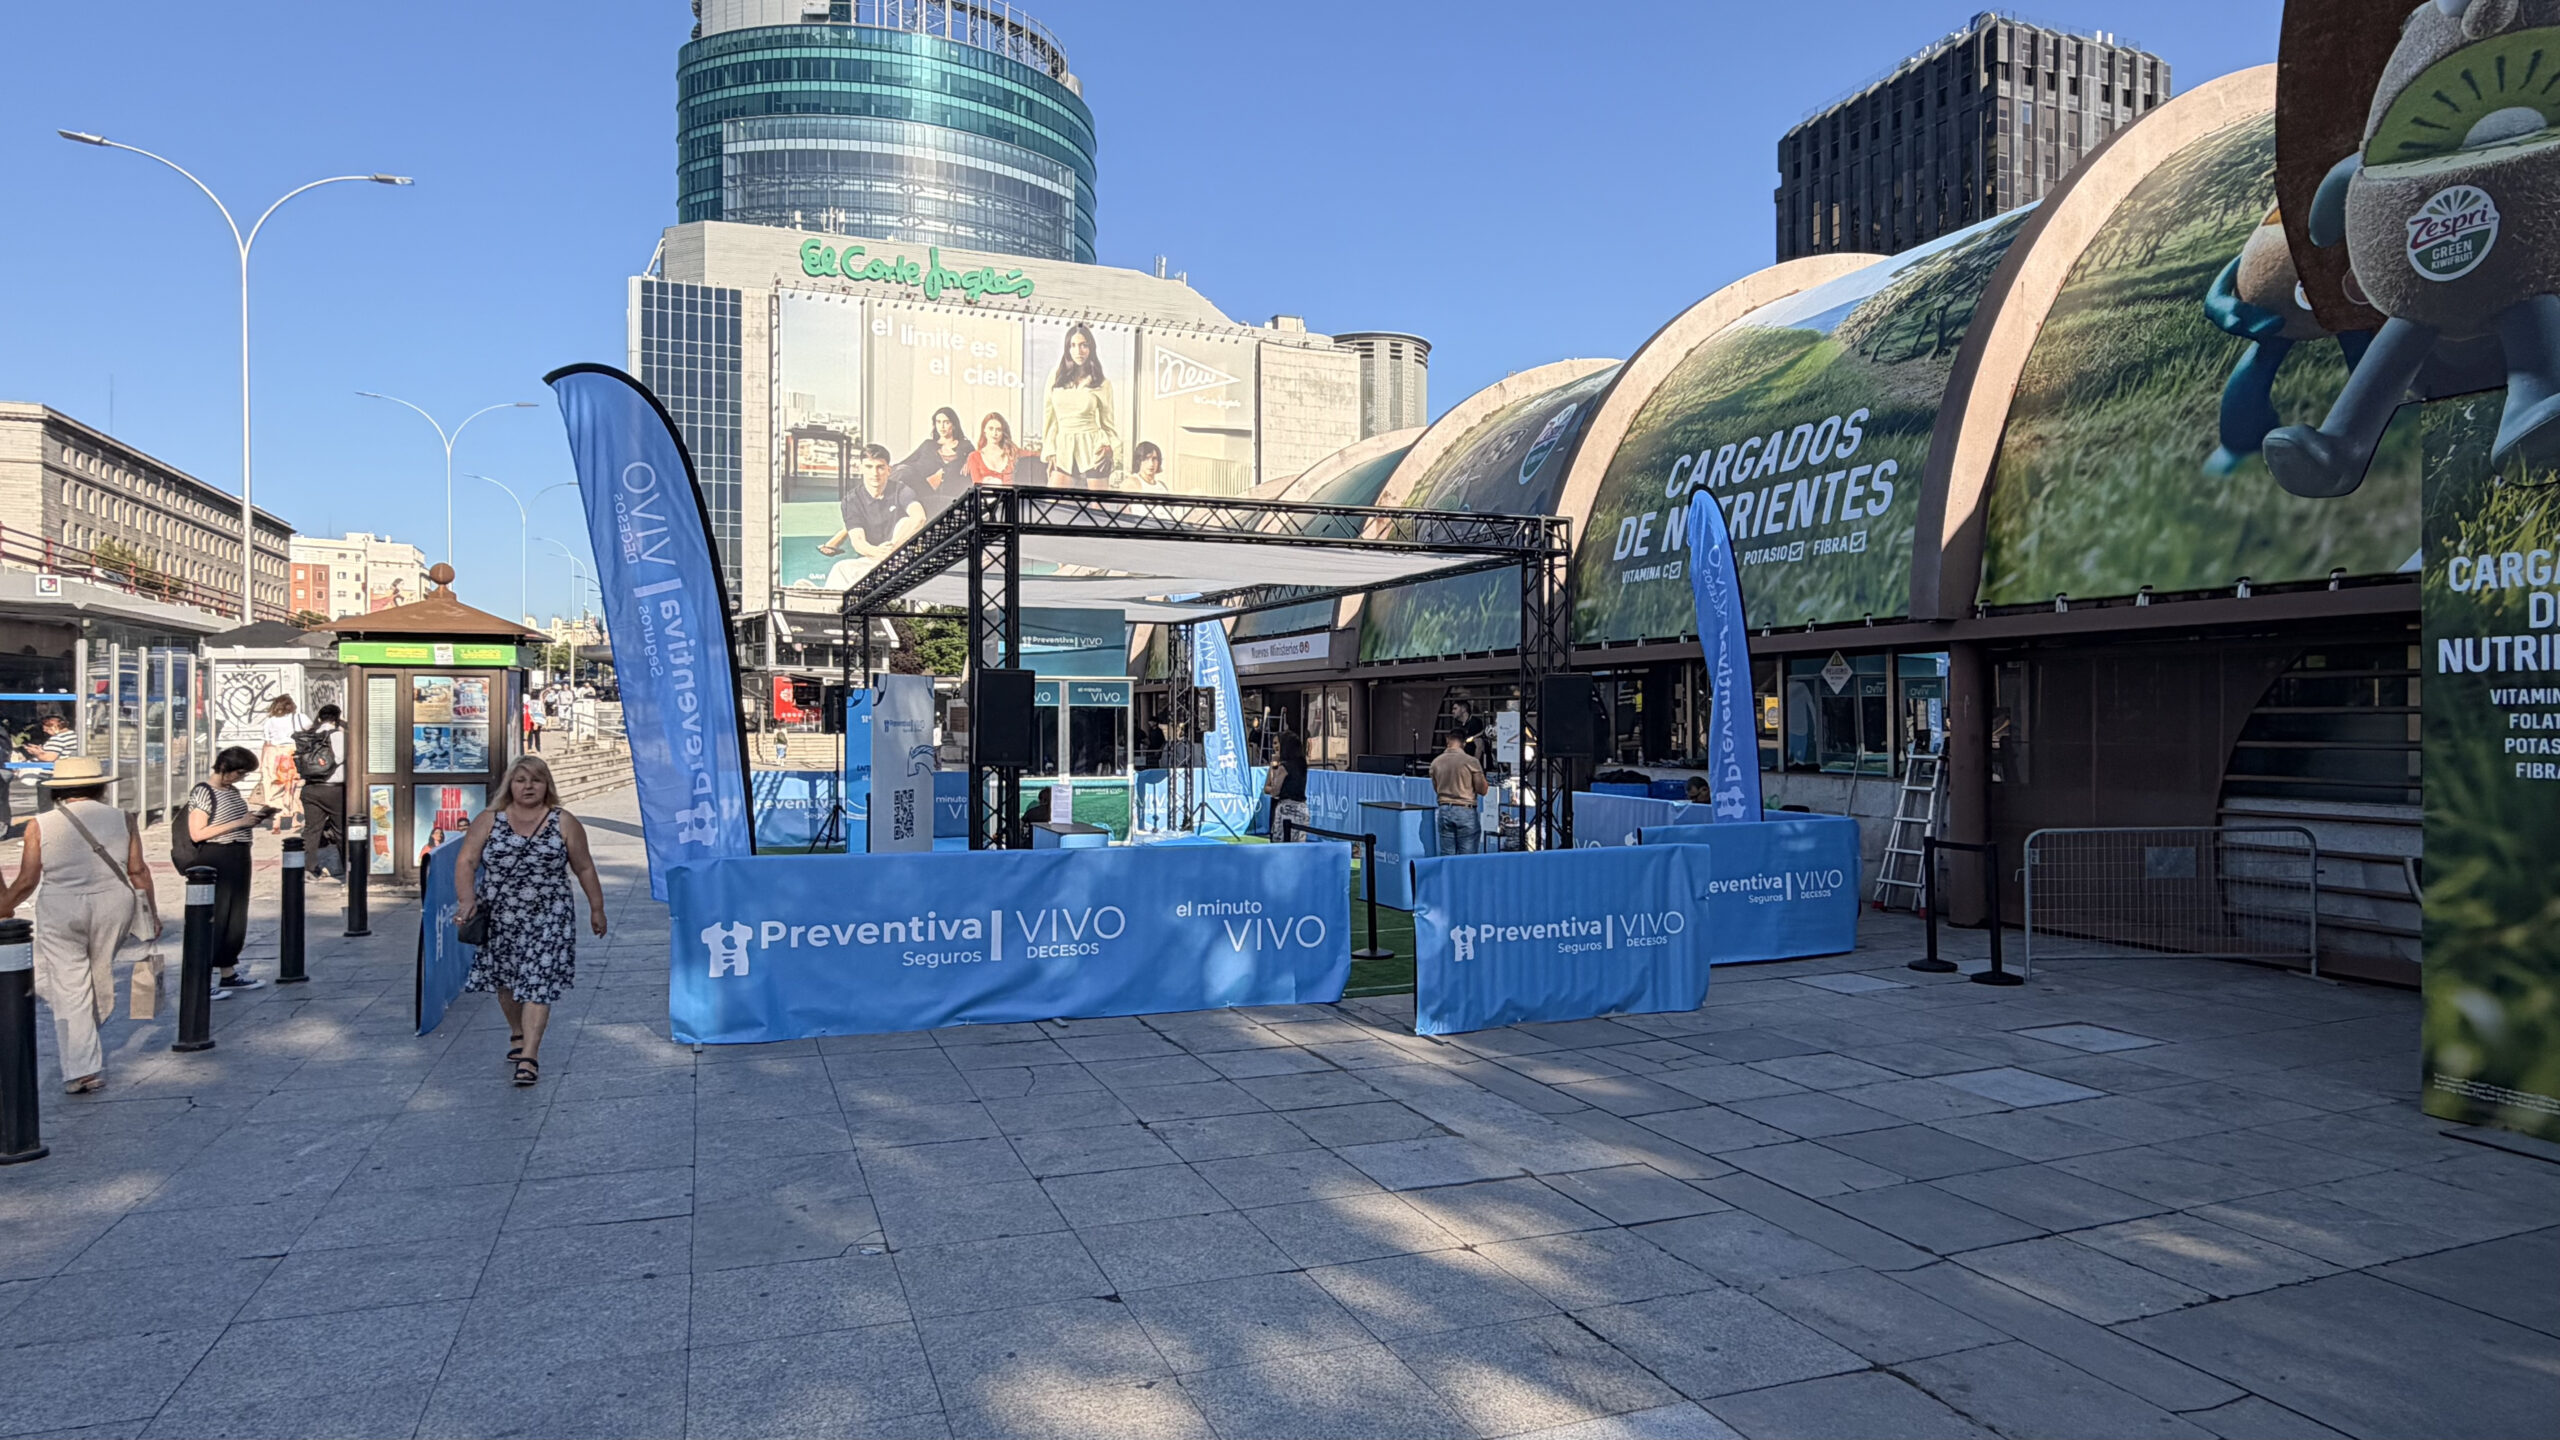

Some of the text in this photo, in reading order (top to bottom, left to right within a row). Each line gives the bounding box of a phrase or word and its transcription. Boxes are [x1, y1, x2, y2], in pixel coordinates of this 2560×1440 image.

[2409, 203, 2489, 250] Zespri
[2431, 251, 2474, 270] KIWIFRUIT
[2432, 239, 2473, 261] GREEN
[800, 238, 838, 277] El
[840, 245, 921, 287] Corte
[871, 316, 894, 337] el
[969, 341, 999, 359] es
[928, 356, 951, 377] el
[1665, 407, 1870, 499] CARGADOS
[1613, 459, 1898, 561] DE NRIENTES
[1743, 545, 1788, 566] POTASIO
[1812, 536, 1848, 556] FIBRA
[1622, 566, 1670, 584] VITAMINA C
[2448, 549, 2560, 592] CARG
[2528, 591, 2560, 629] D
[1079, 637, 1103, 646] VIVO
[1091, 692, 1121, 702] VIVO
[1219, 799, 1263, 814] VIVO
[1709, 869, 1844, 893] eventiva VIVO
[1176, 899, 1263, 917] el minuto
[1748, 889, 1831, 904] Seguros DECESOS
[760, 905, 1126, 950] Preventiva VIVO
[1223, 915, 1326, 952] VIVO
[1480, 911, 1685, 944] Preventiva VIVO
[902, 942, 1100, 969] Seguros DECESOS
[1557, 936, 1668, 954] Seguros DECESOS
